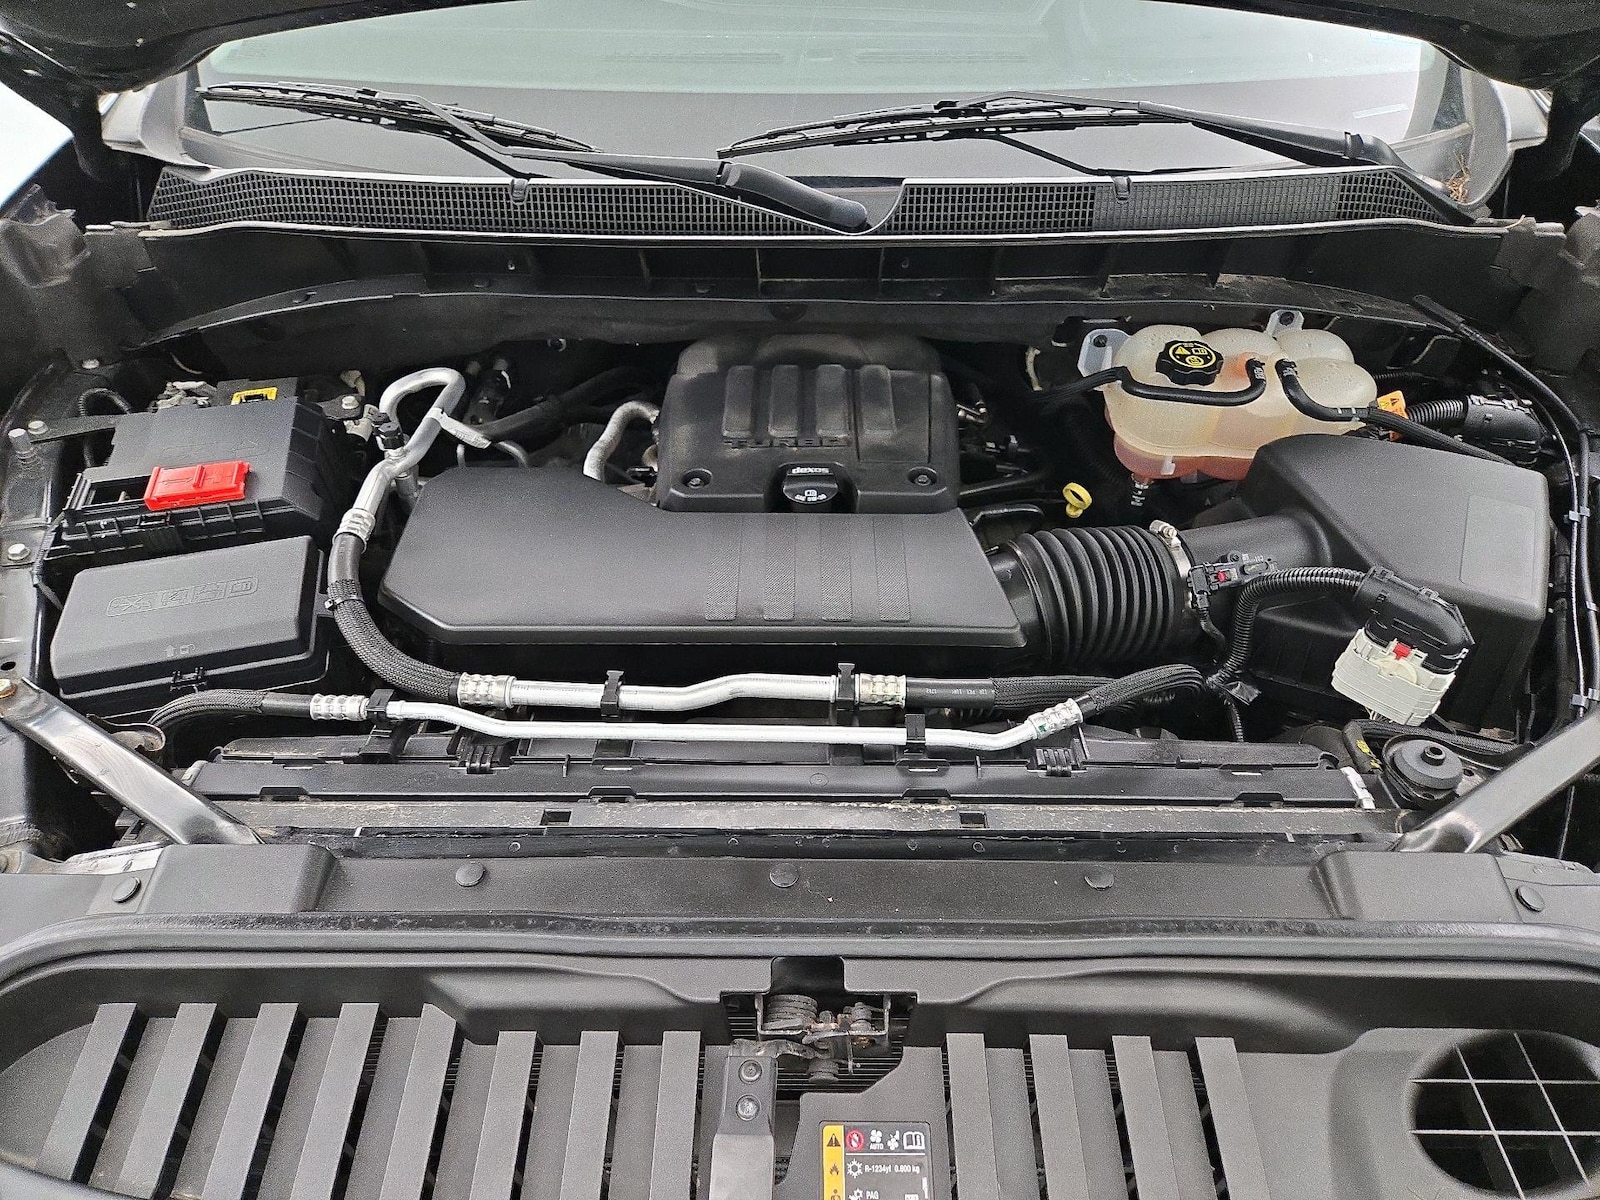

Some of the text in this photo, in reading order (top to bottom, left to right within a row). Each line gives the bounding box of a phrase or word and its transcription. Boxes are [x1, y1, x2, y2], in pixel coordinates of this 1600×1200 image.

[724, 438, 849, 449] TURBO
[912, 1165, 920, 1174] kg
[866, 1190, 879, 1200] PAG
